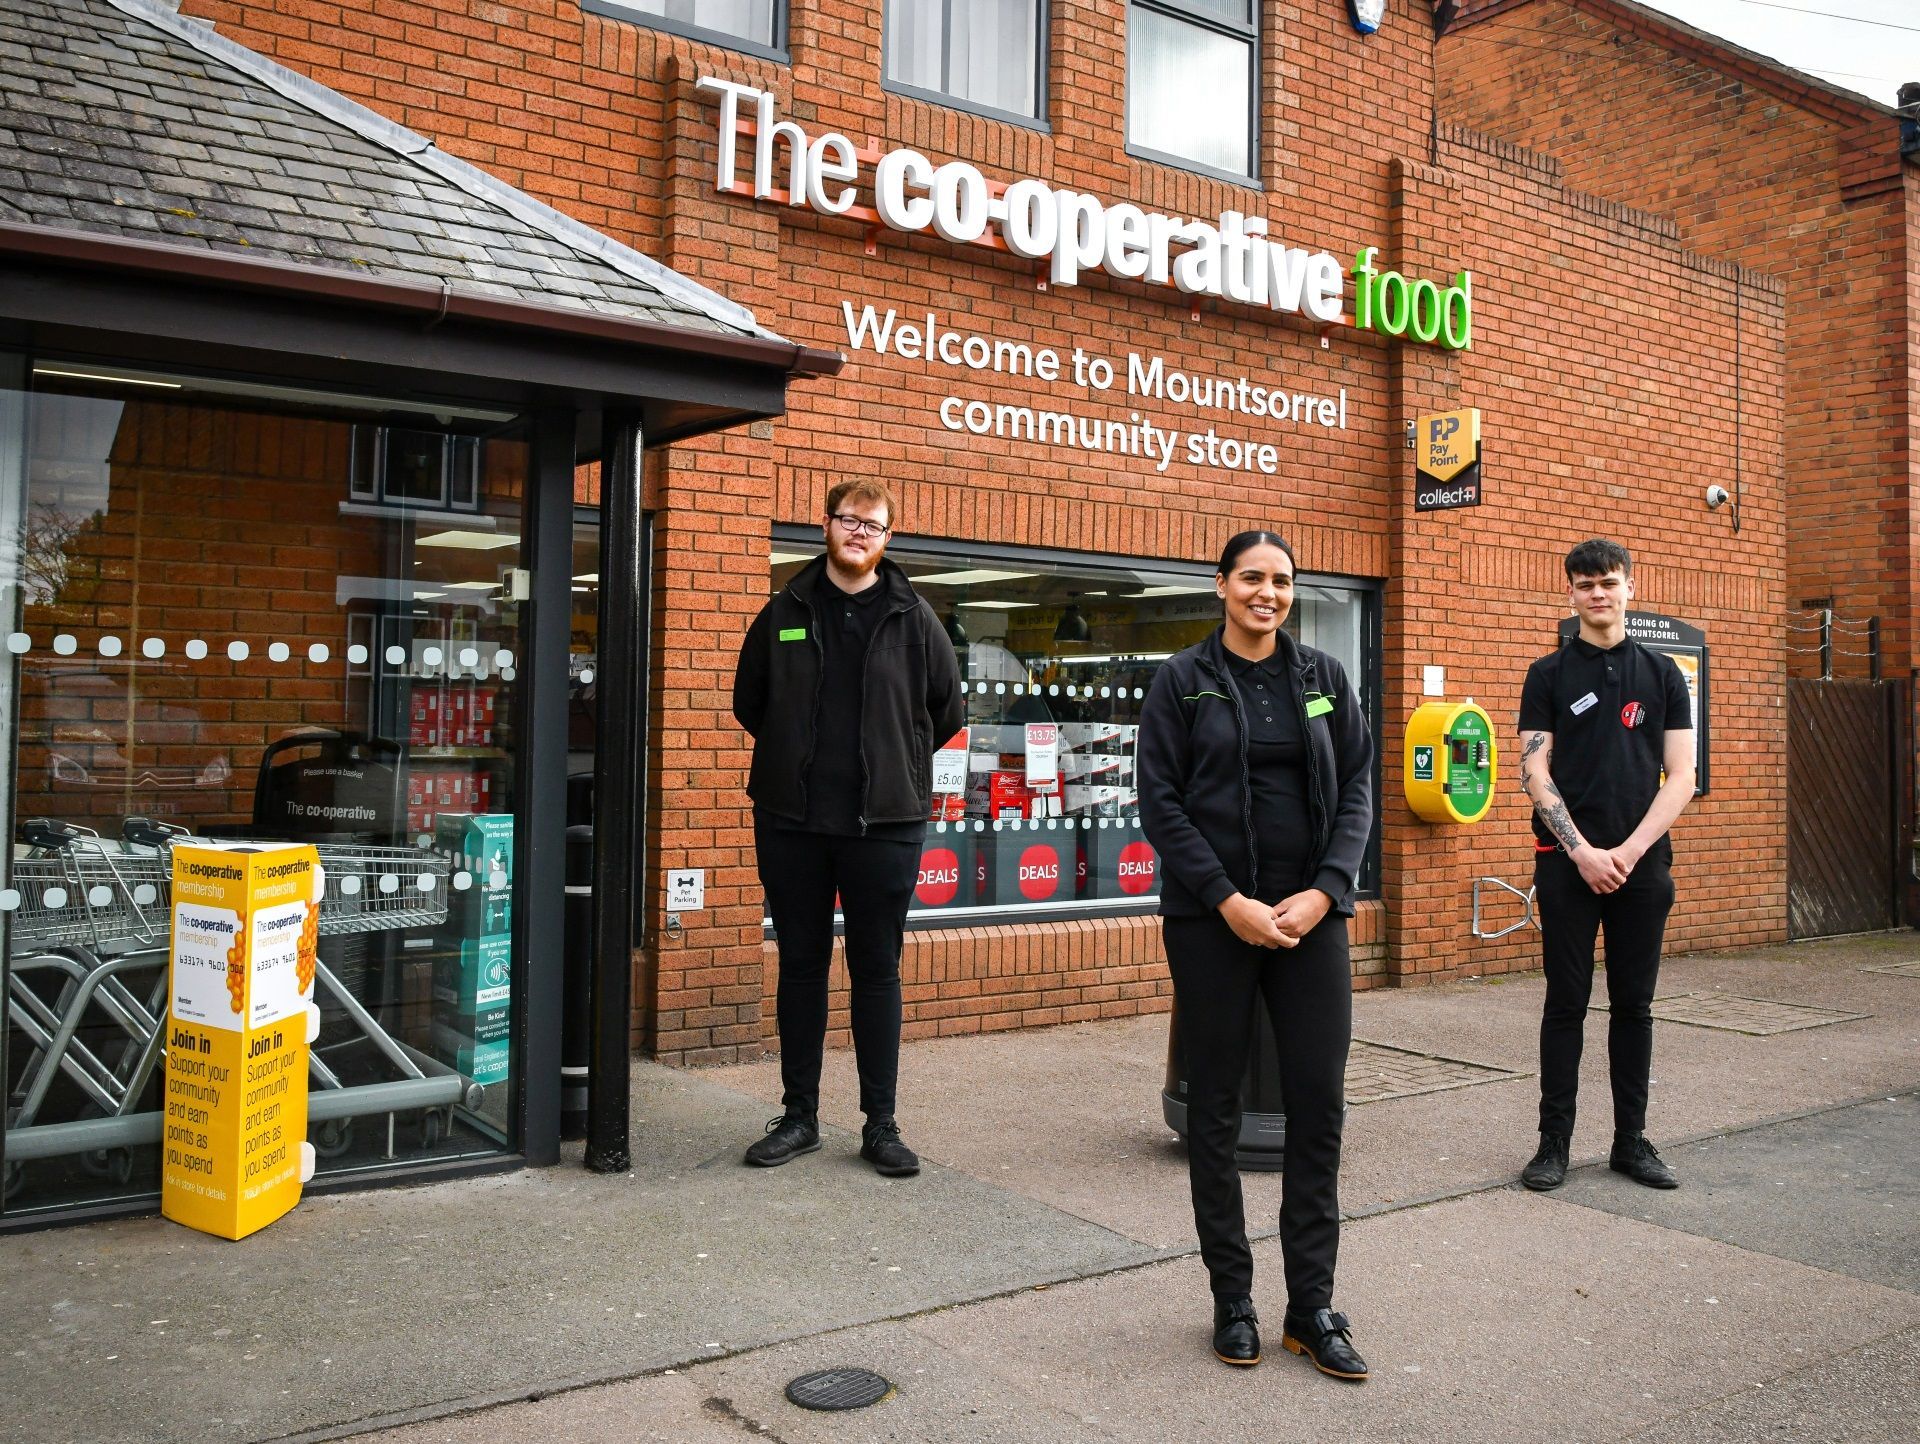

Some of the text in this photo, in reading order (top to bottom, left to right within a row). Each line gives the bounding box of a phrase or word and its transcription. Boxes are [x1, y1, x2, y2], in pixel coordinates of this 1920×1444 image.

[696, 76, 1471, 351] The co-operative food
[842, 300, 1346, 430] Welcome to Mountsorrel
[940, 396, 1278, 474] community store
[1431, 444, 1449, 456] Pay
[1430, 454, 1458, 467] Point
[1631, 618, 1656, 628] GOING
[1659, 620, 1670, 629] ON
[1027, 730, 1055, 741] £13.75
[304, 768, 324, 776] Please
[343, 768, 364, 779] basket
[937, 773, 963, 786] £5.00
[287, 801, 376, 820] The co-operative
[177, 858, 243, 880] The co-operative
[254, 859, 310, 880] The co-operative
[916, 868, 958, 885] DEALS
[1019, 864, 1058, 881] DEALS
[1119, 860, 1154, 875] DEALS
[177, 880, 224, 900] membership
[254, 881, 297, 900] membership
[488, 892, 509, 901] distancing
[180, 913, 234, 934] The co-operative
[257, 912, 302, 932] The co-operative
[180, 931, 218, 948] membership
[257, 931, 291, 949] membership
[179, 954, 204, 967] 633174
[208, 959, 226, 971] 9601
[257, 956, 279, 971] 633174
[282, 952, 296, 963] 9601
[495, 1011, 505, 1019] Kind
[171, 1027, 211, 1054] Join in
[248, 1031, 283, 1059] Join in
[170, 1052, 229, 1083] Support your
[247, 1050, 296, 1083] Support your
[169, 1079, 220, 1107] community
[246, 1076, 289, 1107] community
[169, 1101, 209, 1125] and earn
[246, 1102, 281, 1131] and earn
[168, 1124, 208, 1149] points as
[245, 1125, 281, 1155] points as
[167, 1148, 213, 1175] you spend
[244, 1145, 286, 1182] you spend
[181, 1180, 195, 1193] store
[206, 1186, 226, 1201] details
